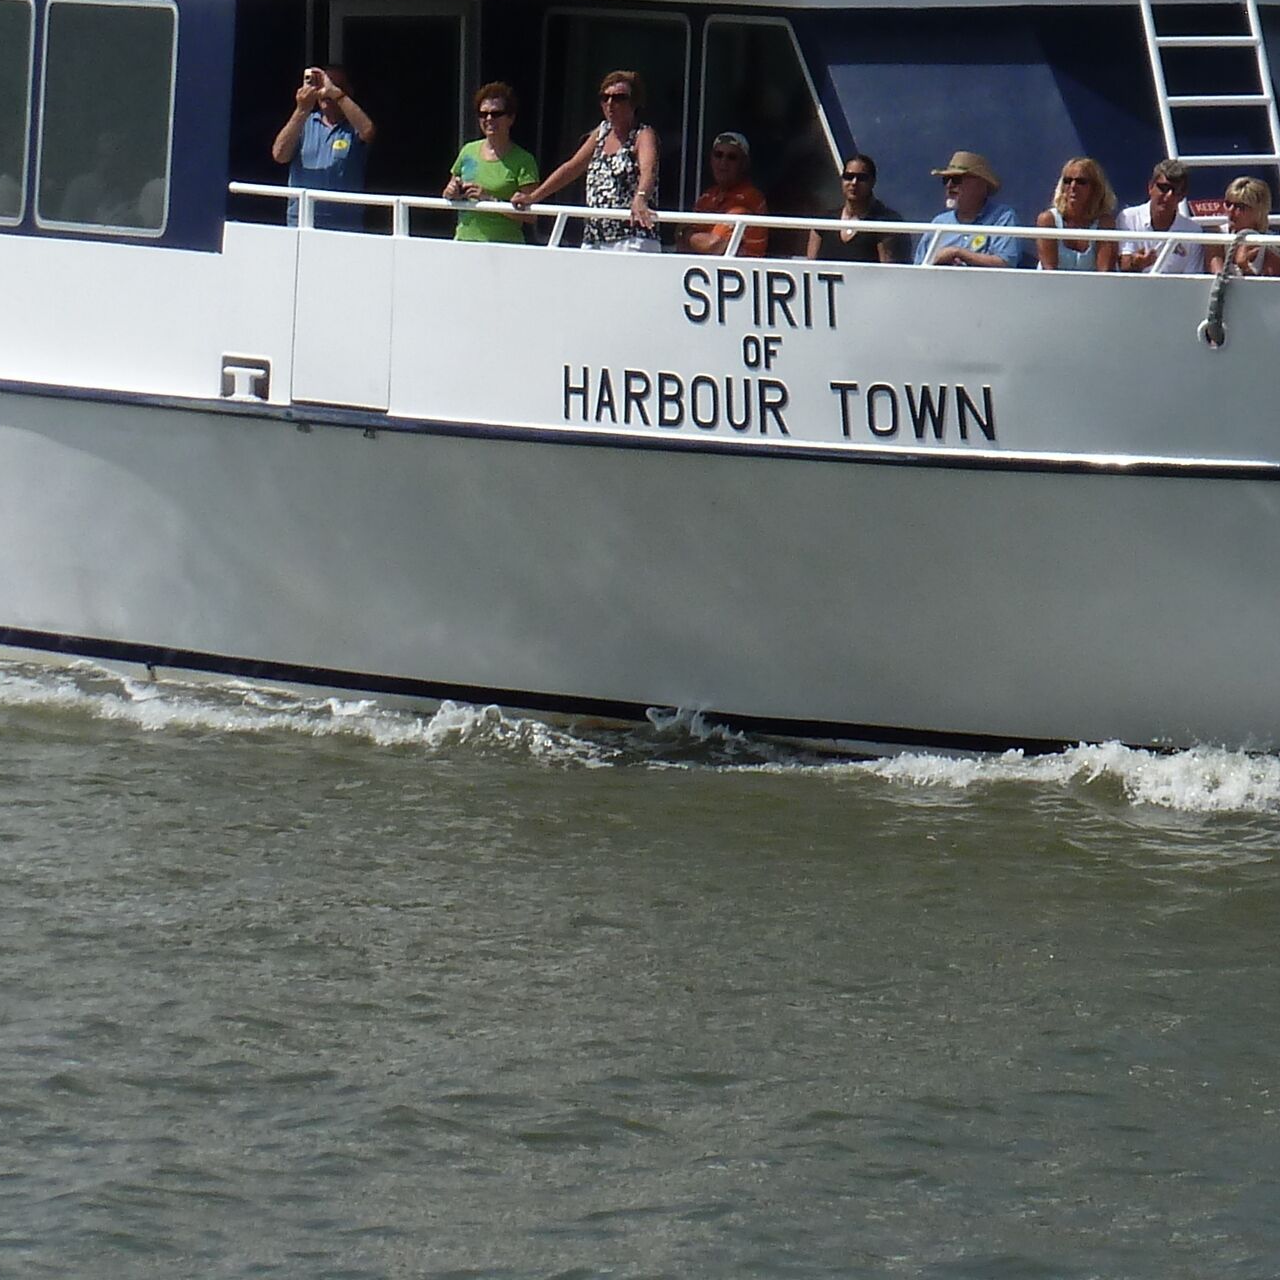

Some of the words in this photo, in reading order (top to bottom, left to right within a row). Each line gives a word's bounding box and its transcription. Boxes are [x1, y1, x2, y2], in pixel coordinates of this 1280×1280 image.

[1195, 202, 1221, 212] KEEP
[683, 267, 844, 328] SPIRIT
[742, 335, 782, 370] OF
[564, 365, 789, 435] HARBOUR
[829, 382, 997, 442] TOWN
